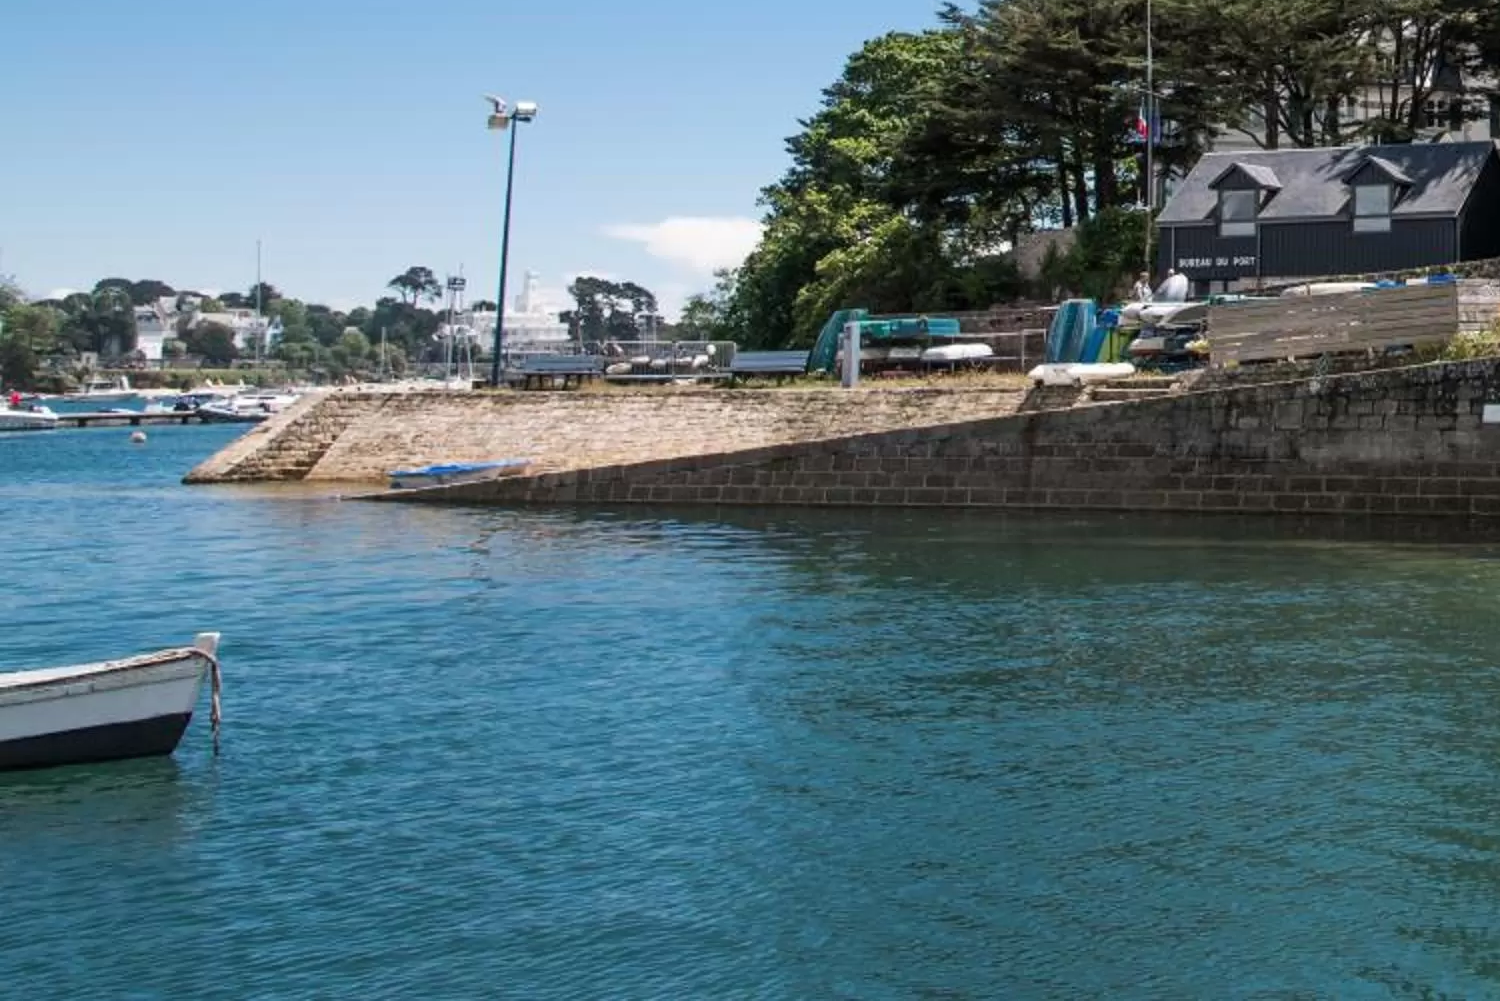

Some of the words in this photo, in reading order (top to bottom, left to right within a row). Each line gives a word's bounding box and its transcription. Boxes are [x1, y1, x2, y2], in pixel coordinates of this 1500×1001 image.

[1178, 257, 1213, 268] BUREAU
[1215, 257, 1229, 267] DU
[1233, 255, 1256, 267] PORT
